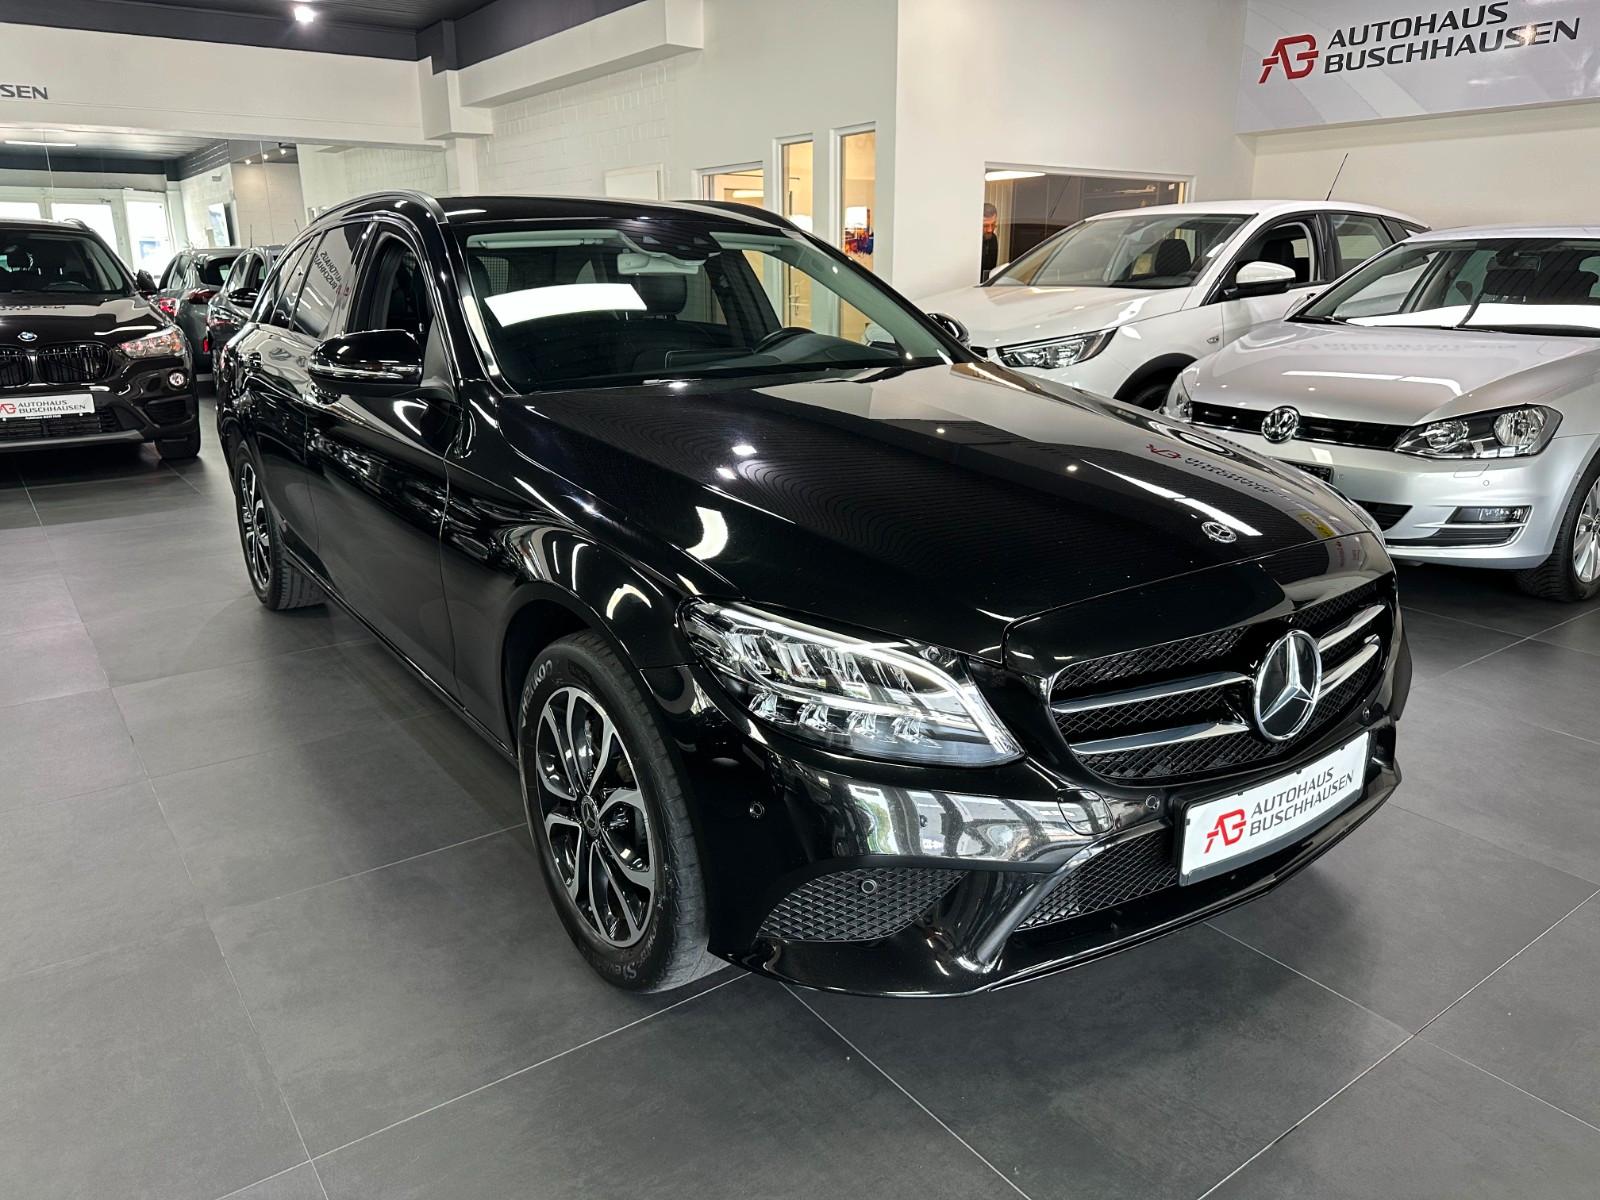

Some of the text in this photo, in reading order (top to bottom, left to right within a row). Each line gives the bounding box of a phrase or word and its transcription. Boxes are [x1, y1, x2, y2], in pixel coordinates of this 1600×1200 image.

[1324, 17, 1580, 74] BUSCHHAUSEN
[1328, 1, 1508, 50] AUTOHAUS
[18, 400, 68, 408] AUTOHAUS
[19, 404, 86, 414] BUSCHHAUSEN
[1249, 769, 1354, 837] BUSCHHAUSEN
[1251, 766, 1334, 818] AUTOHAUS
